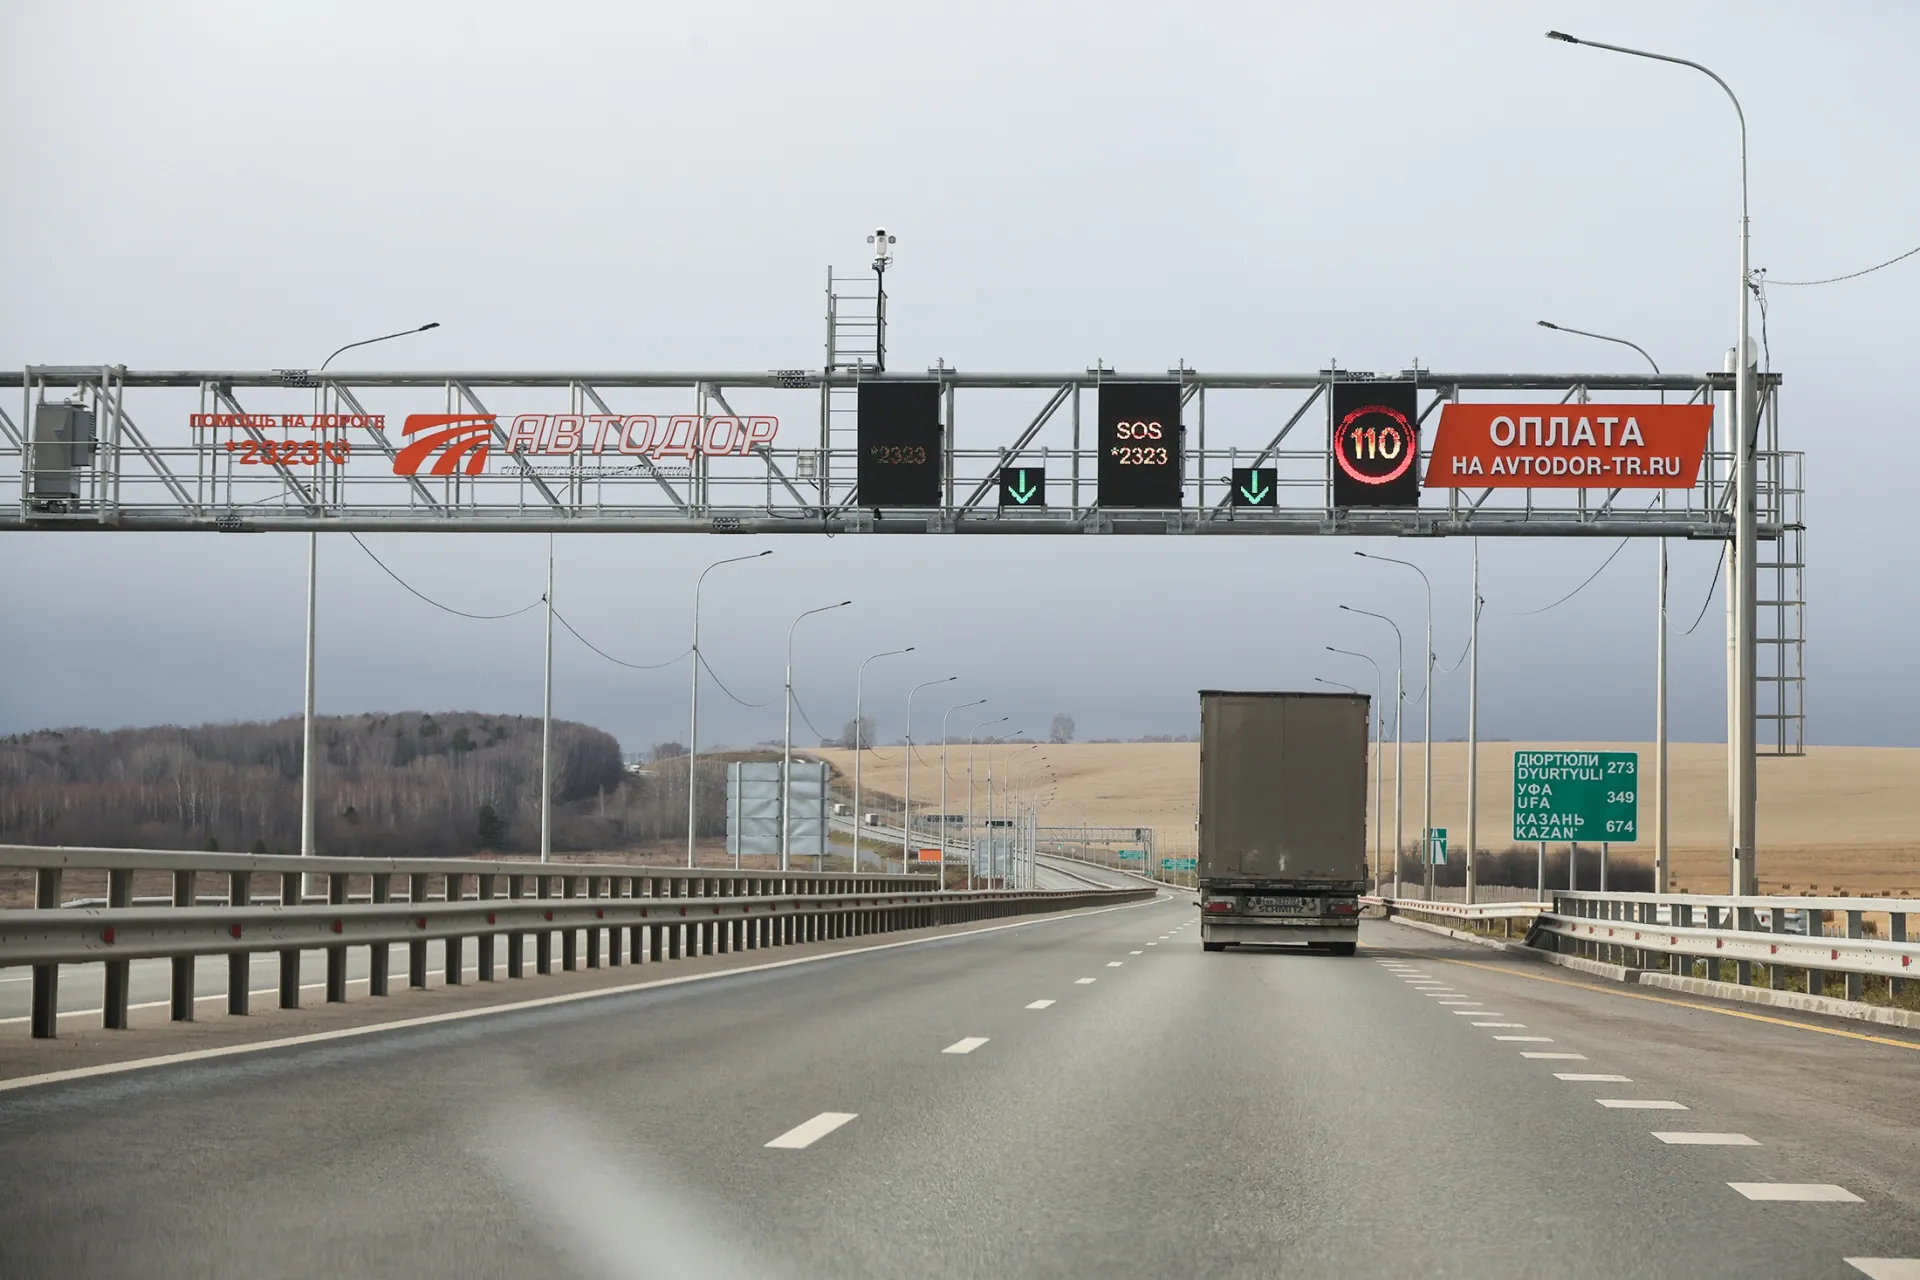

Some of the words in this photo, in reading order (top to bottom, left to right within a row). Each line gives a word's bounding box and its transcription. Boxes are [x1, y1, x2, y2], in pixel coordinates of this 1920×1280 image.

[190, 413, 276, 431] ПОМОЩЬ
[281, 413, 306, 428] НА
[311, 413, 385, 431] ДОРОГЕ
[505, 413, 779, 460] АВТОДОР
[1116, 421, 1163, 440] SOS
[1490, 416, 1645, 447] ОПЛАТА
[1350, 427, 1402, 460] 110
[1452, 456, 1483, 475] НА
[1490, 456, 1680, 476] AVTODOR-TR.RU
[1517, 753, 1599, 768] ДЮРТЮЛИ
[1518, 767, 1603, 780] DYURTYULI
[1607, 761, 1635, 774] 273
[1517, 783, 1553, 796] УФА
[1517, 796, 1551, 809] UFA
[1607, 791, 1635, 803] 349
[1516, 813, 1585, 826] КАЗАНЬ
[1606, 820, 1634, 833] 674
[1258, 905, 1304, 914] SCHMITZ
